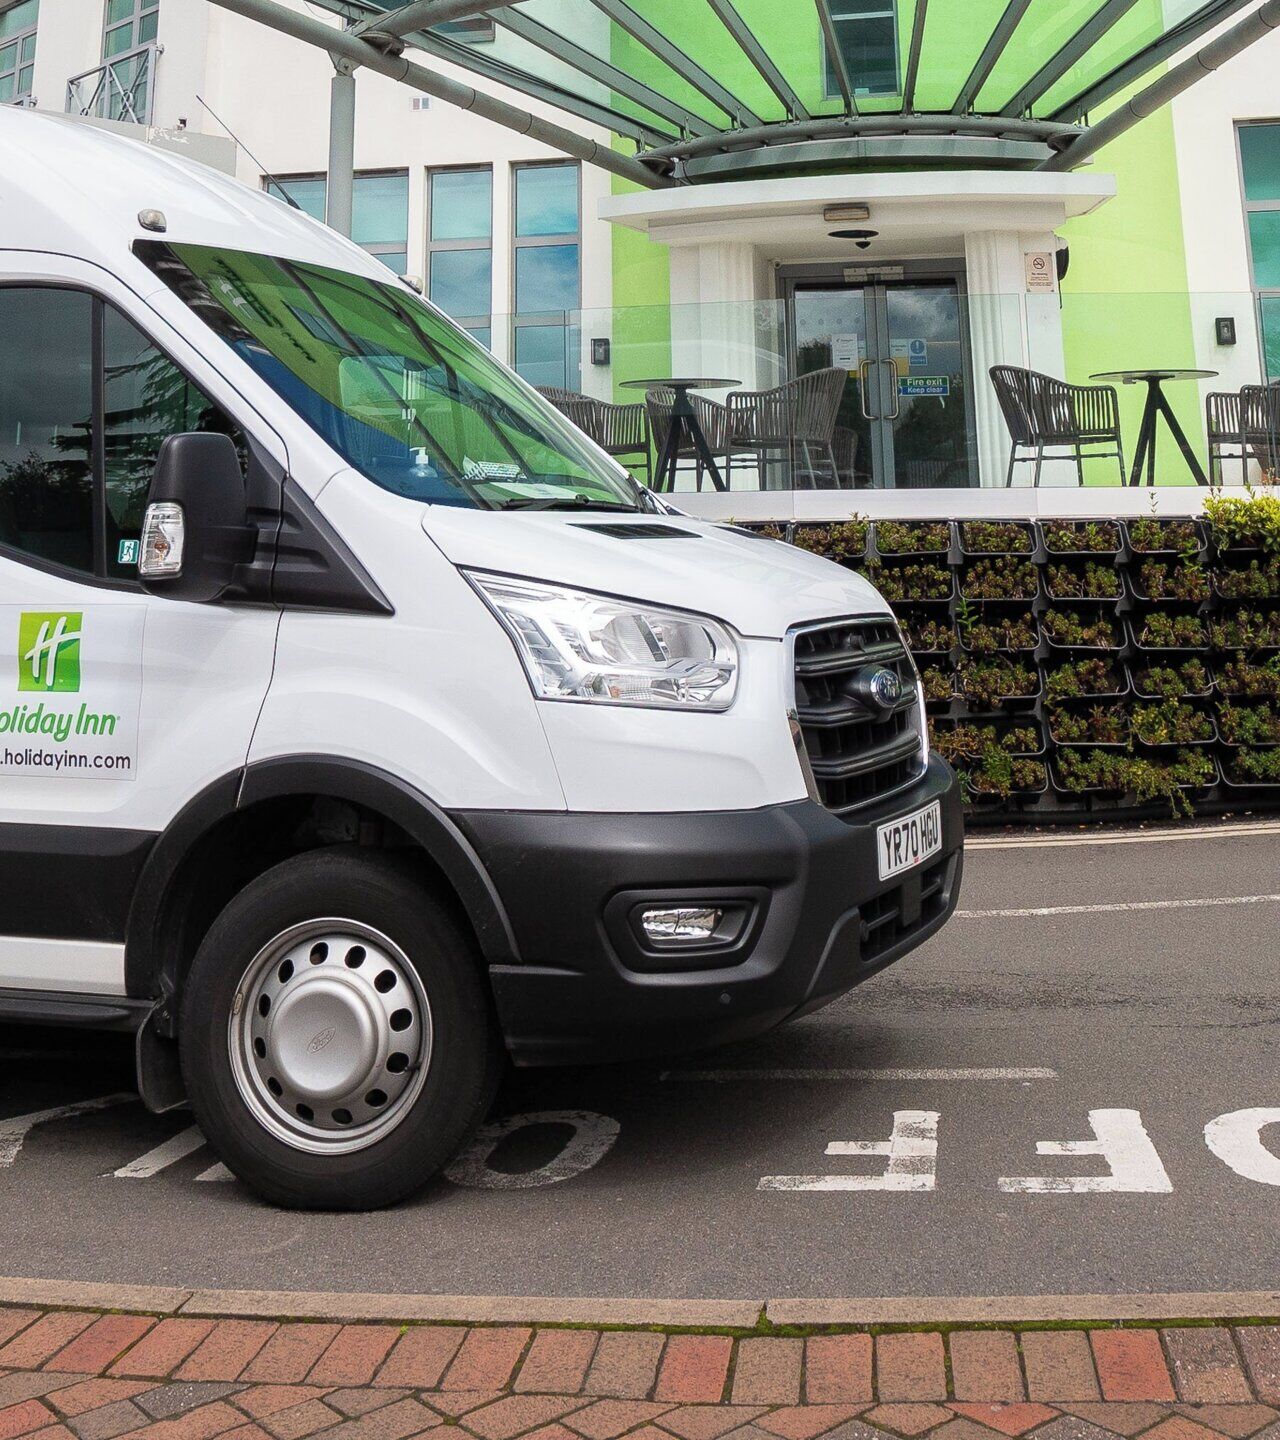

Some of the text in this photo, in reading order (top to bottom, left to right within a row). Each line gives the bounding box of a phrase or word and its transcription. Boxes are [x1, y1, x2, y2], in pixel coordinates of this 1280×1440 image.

[907, 378, 942, 386] Fire exit
[75, 703, 117, 735] Inn
[884, 808, 938, 869] YR70 HGU
